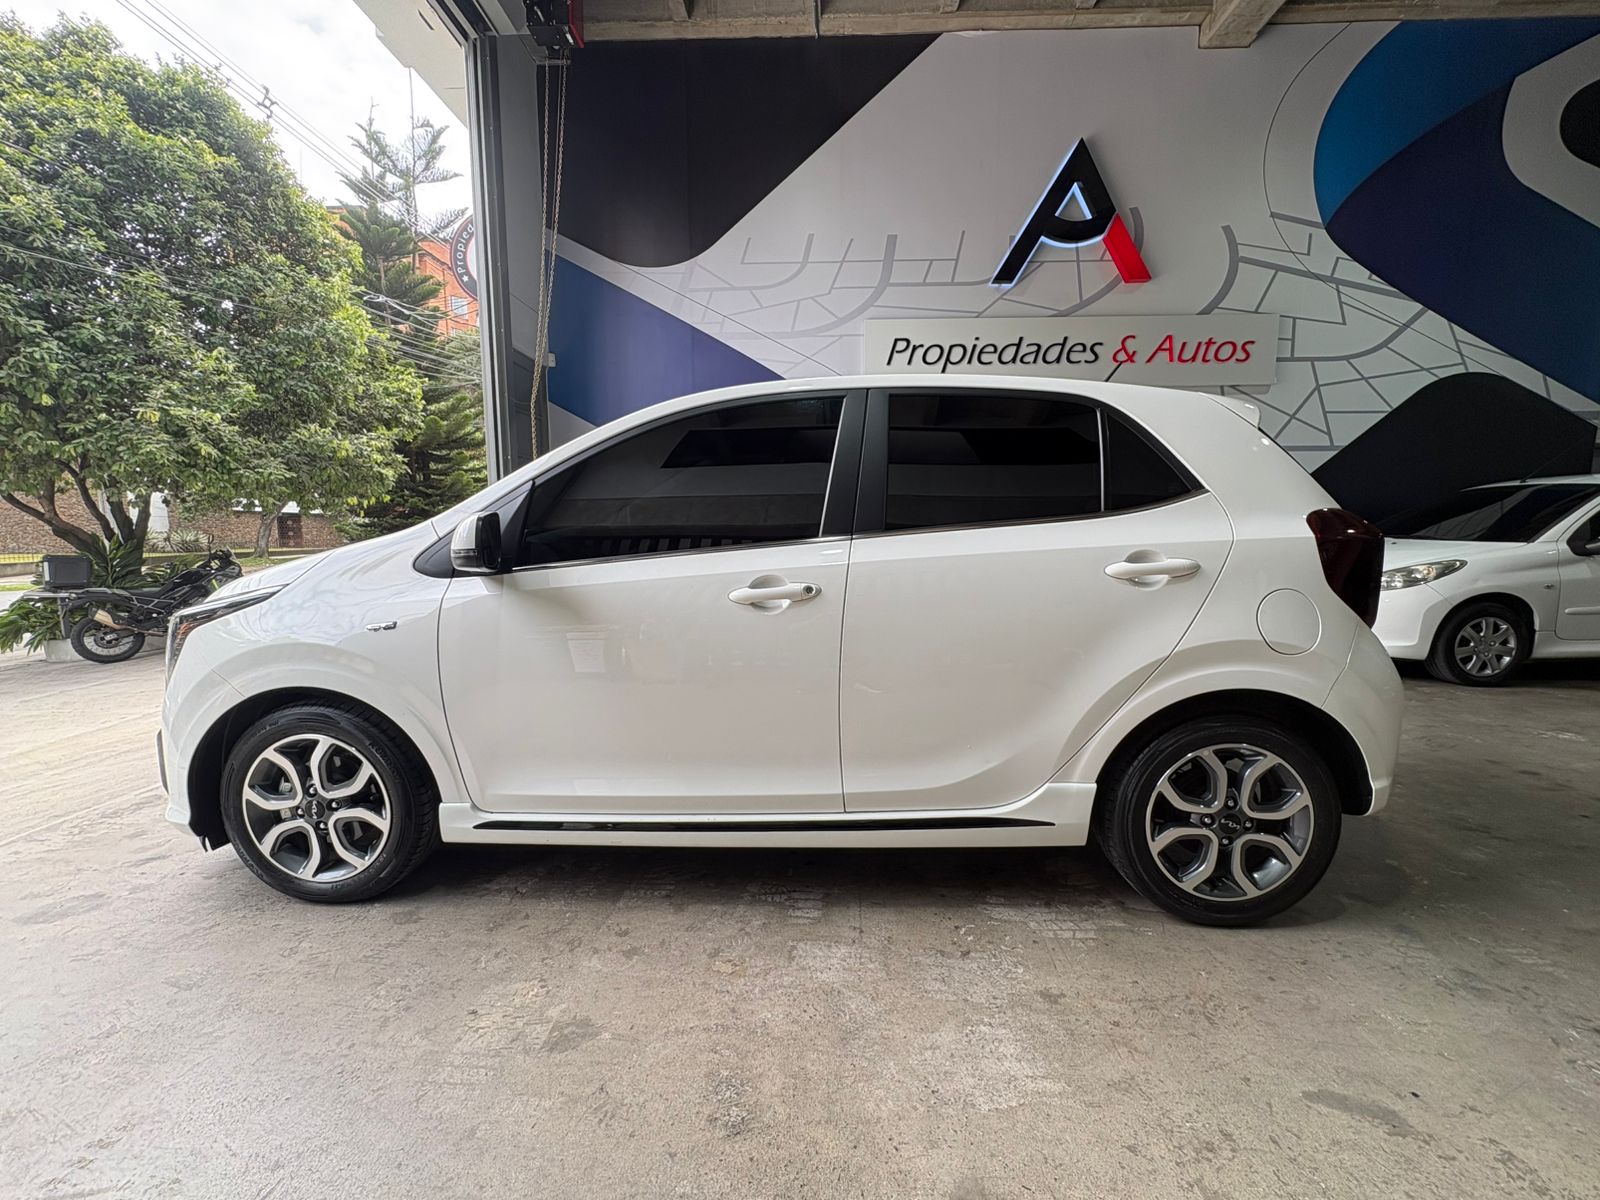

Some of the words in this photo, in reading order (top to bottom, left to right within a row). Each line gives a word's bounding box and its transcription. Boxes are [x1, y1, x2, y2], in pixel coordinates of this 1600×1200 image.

[886, 336, 1103, 373] Propiedades
[1111, 334, 1137, 364] &
[1146, 333, 1256, 364] Autos
